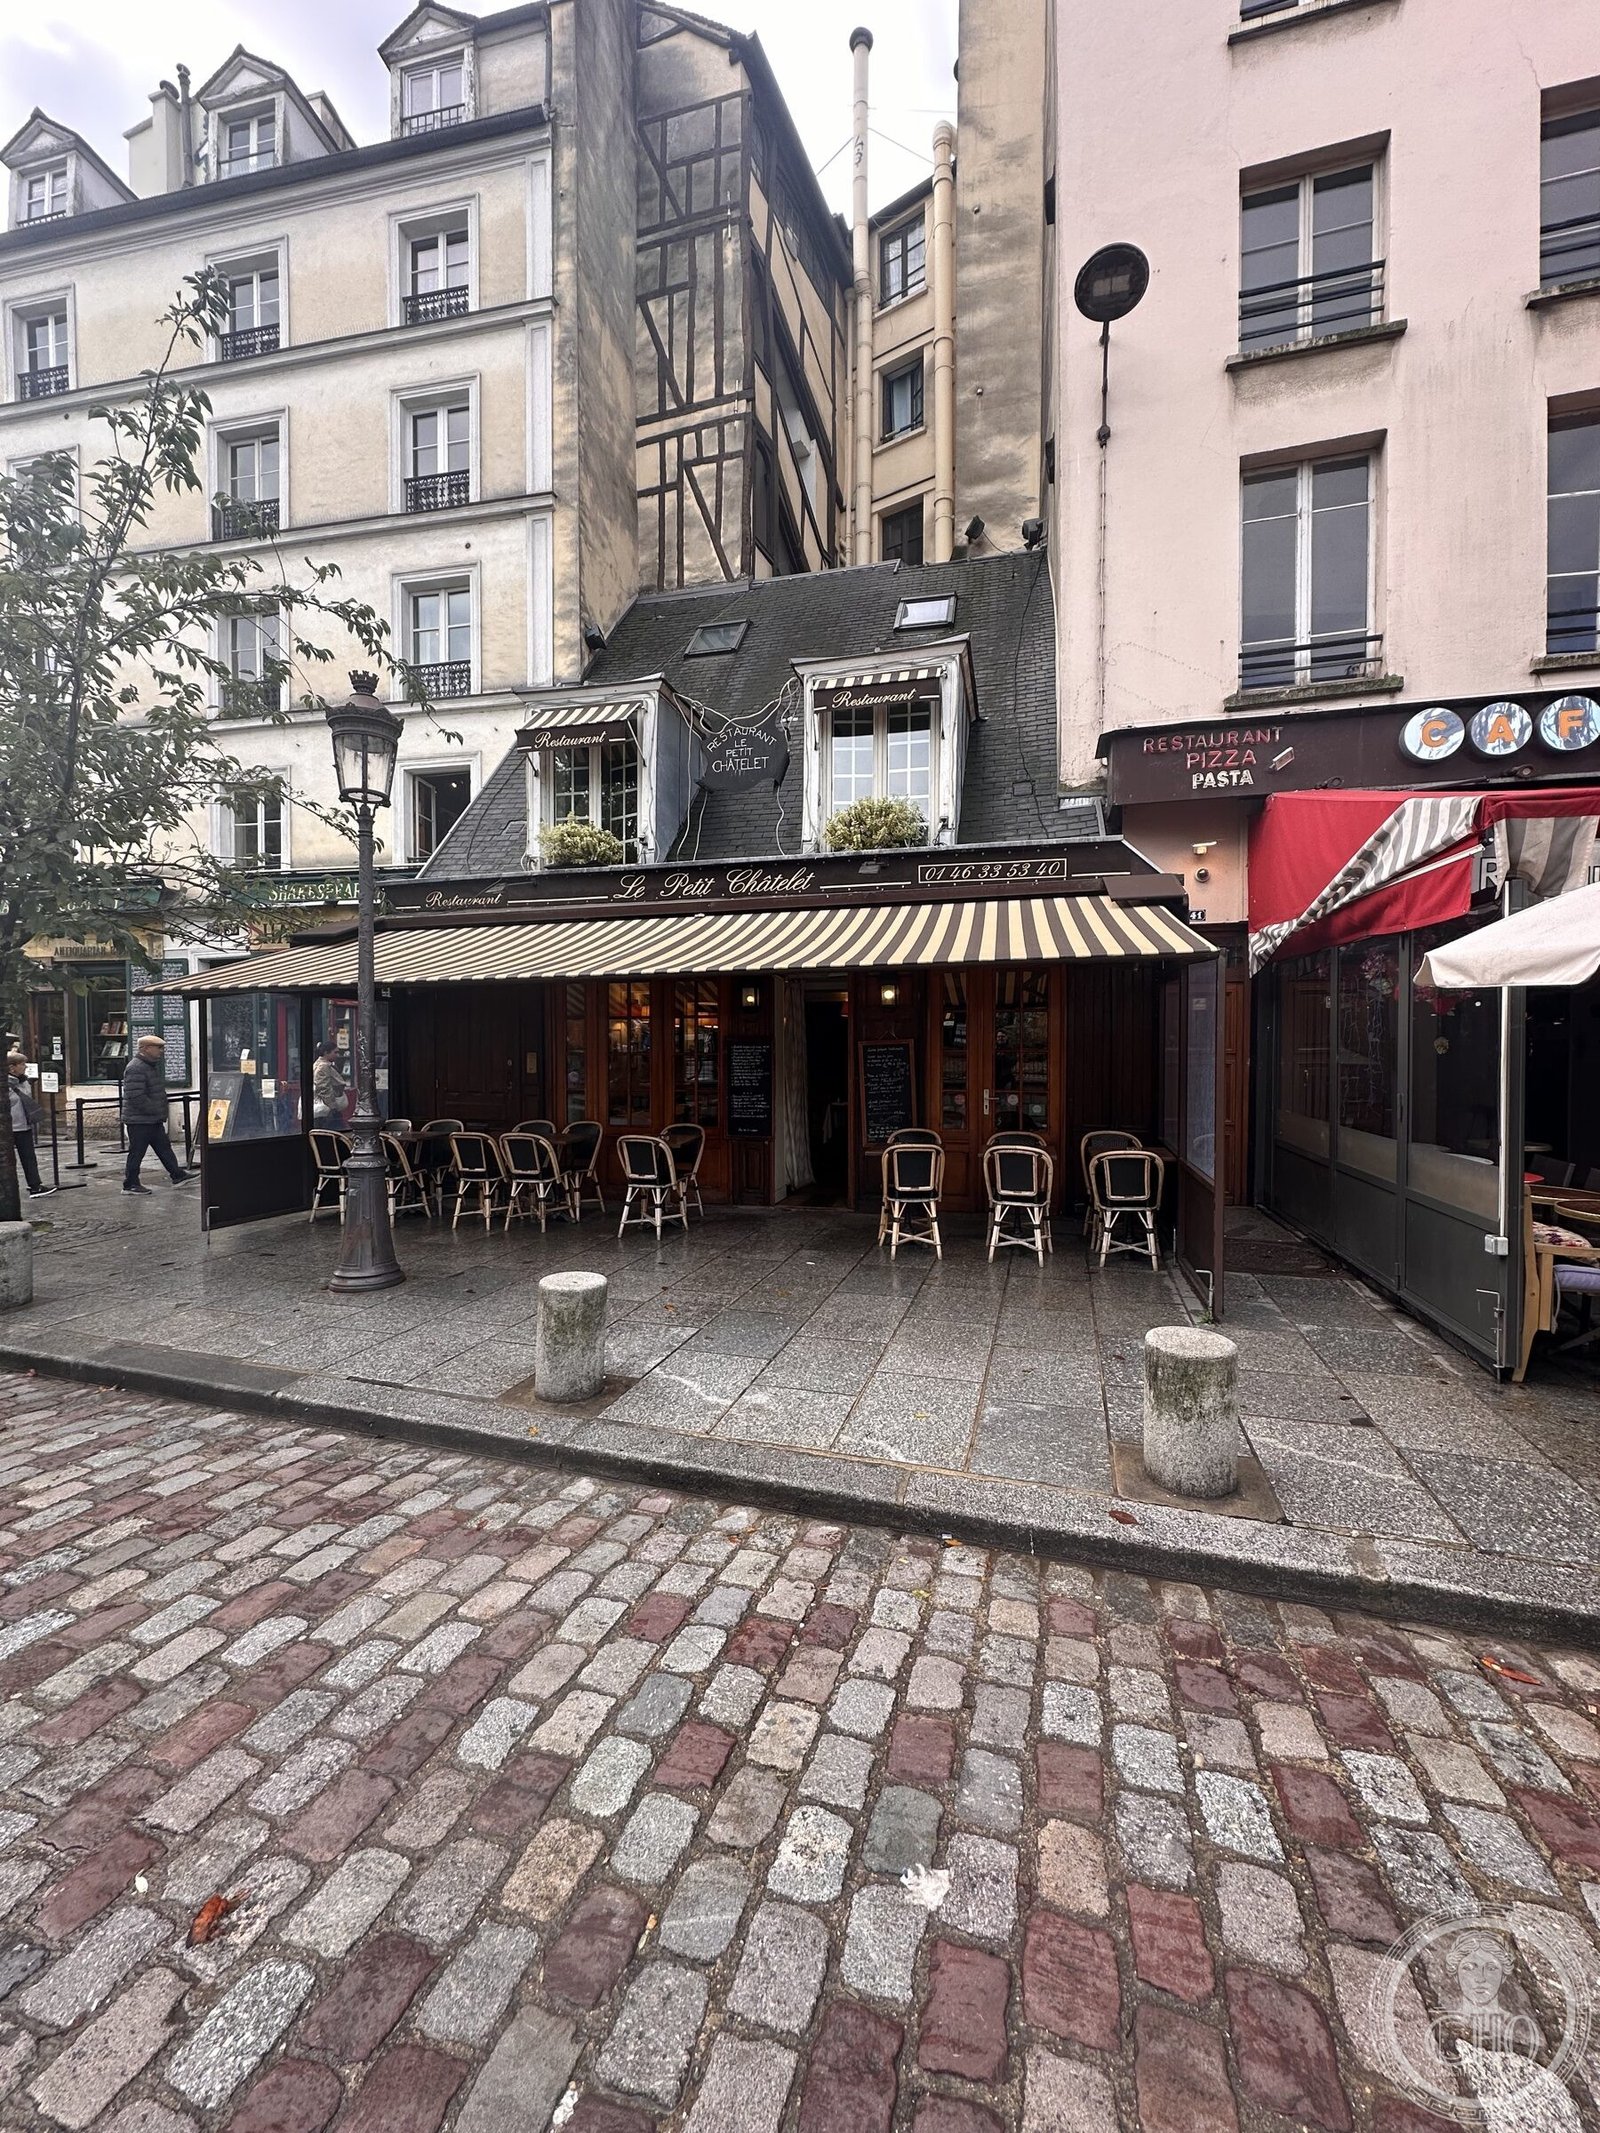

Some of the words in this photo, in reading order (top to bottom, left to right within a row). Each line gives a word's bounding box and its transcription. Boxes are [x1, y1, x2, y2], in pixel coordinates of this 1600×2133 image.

[832, 688, 916, 708] Restaurant
[534, 730, 606, 749] Restaurant
[706, 726, 777, 752] RESTAURANT
[734, 738, 747, 748] LE
[1143, 726, 1284, 752] RESTAURANT
[725, 747, 753, 757] PETIT
[1186, 749, 1257, 769] PIZZA
[1192, 769, 1254, 789] PASTA
[925, 867, 946, 880] 01
[950, 865, 975, 878] 46
[978, 864, 1002, 878] 33
[1006, 862, 1031, 877] 53
[1036, 861, 1061, 875] 40
[269, 882, 360, 901] SHAKESPEAR
[613, 875, 646, 899] Le
[660, 873, 715, 896] Petit
[726, 866, 816, 894] Châtelet
[425, 891, 502, 908] Restaurant
[1189, 911, 1203, 920] 41
